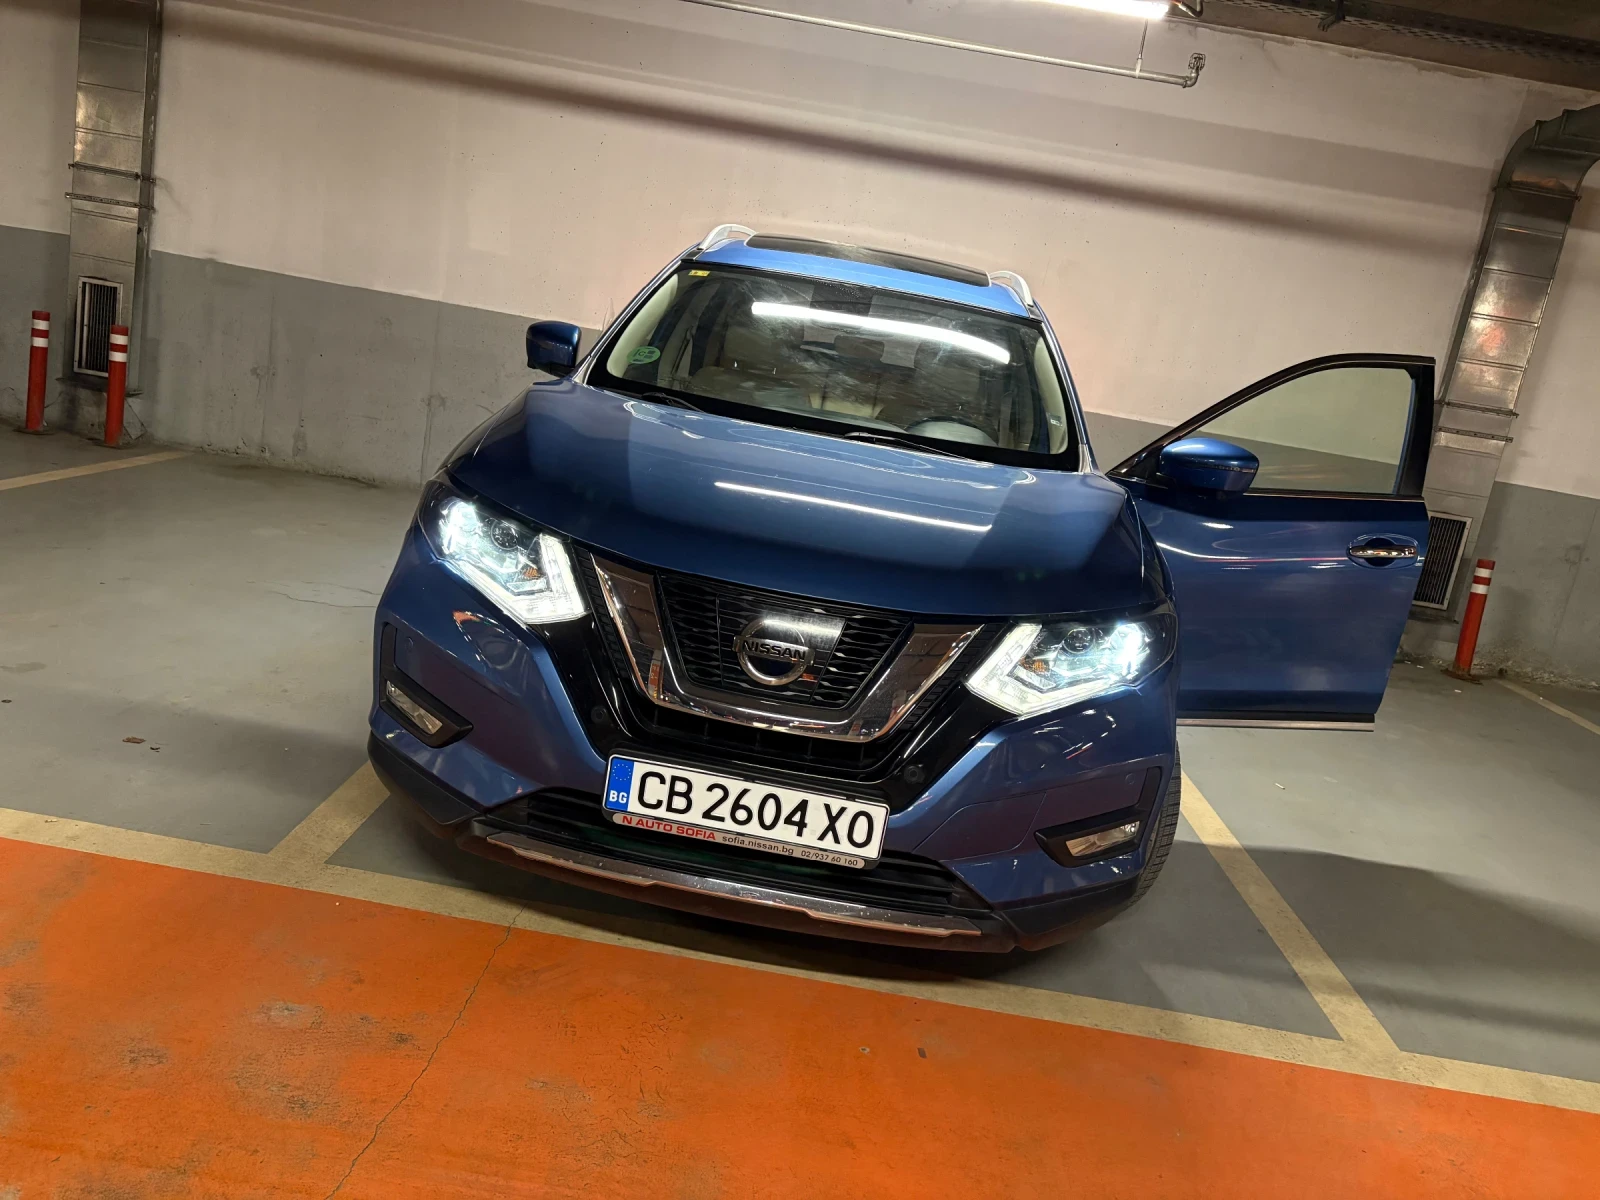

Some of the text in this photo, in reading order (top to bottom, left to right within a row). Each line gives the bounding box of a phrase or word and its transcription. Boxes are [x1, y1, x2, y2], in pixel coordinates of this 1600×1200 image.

[742, 639, 806, 660] NISSAN
[609, 790, 628, 804] BG
[637, 771, 875, 849] CB 2604 XO
[622, 815, 716, 841] N AUTO SOFIA
[722, 834, 858, 866] sofia.nissan.bg 02/937 60 160
